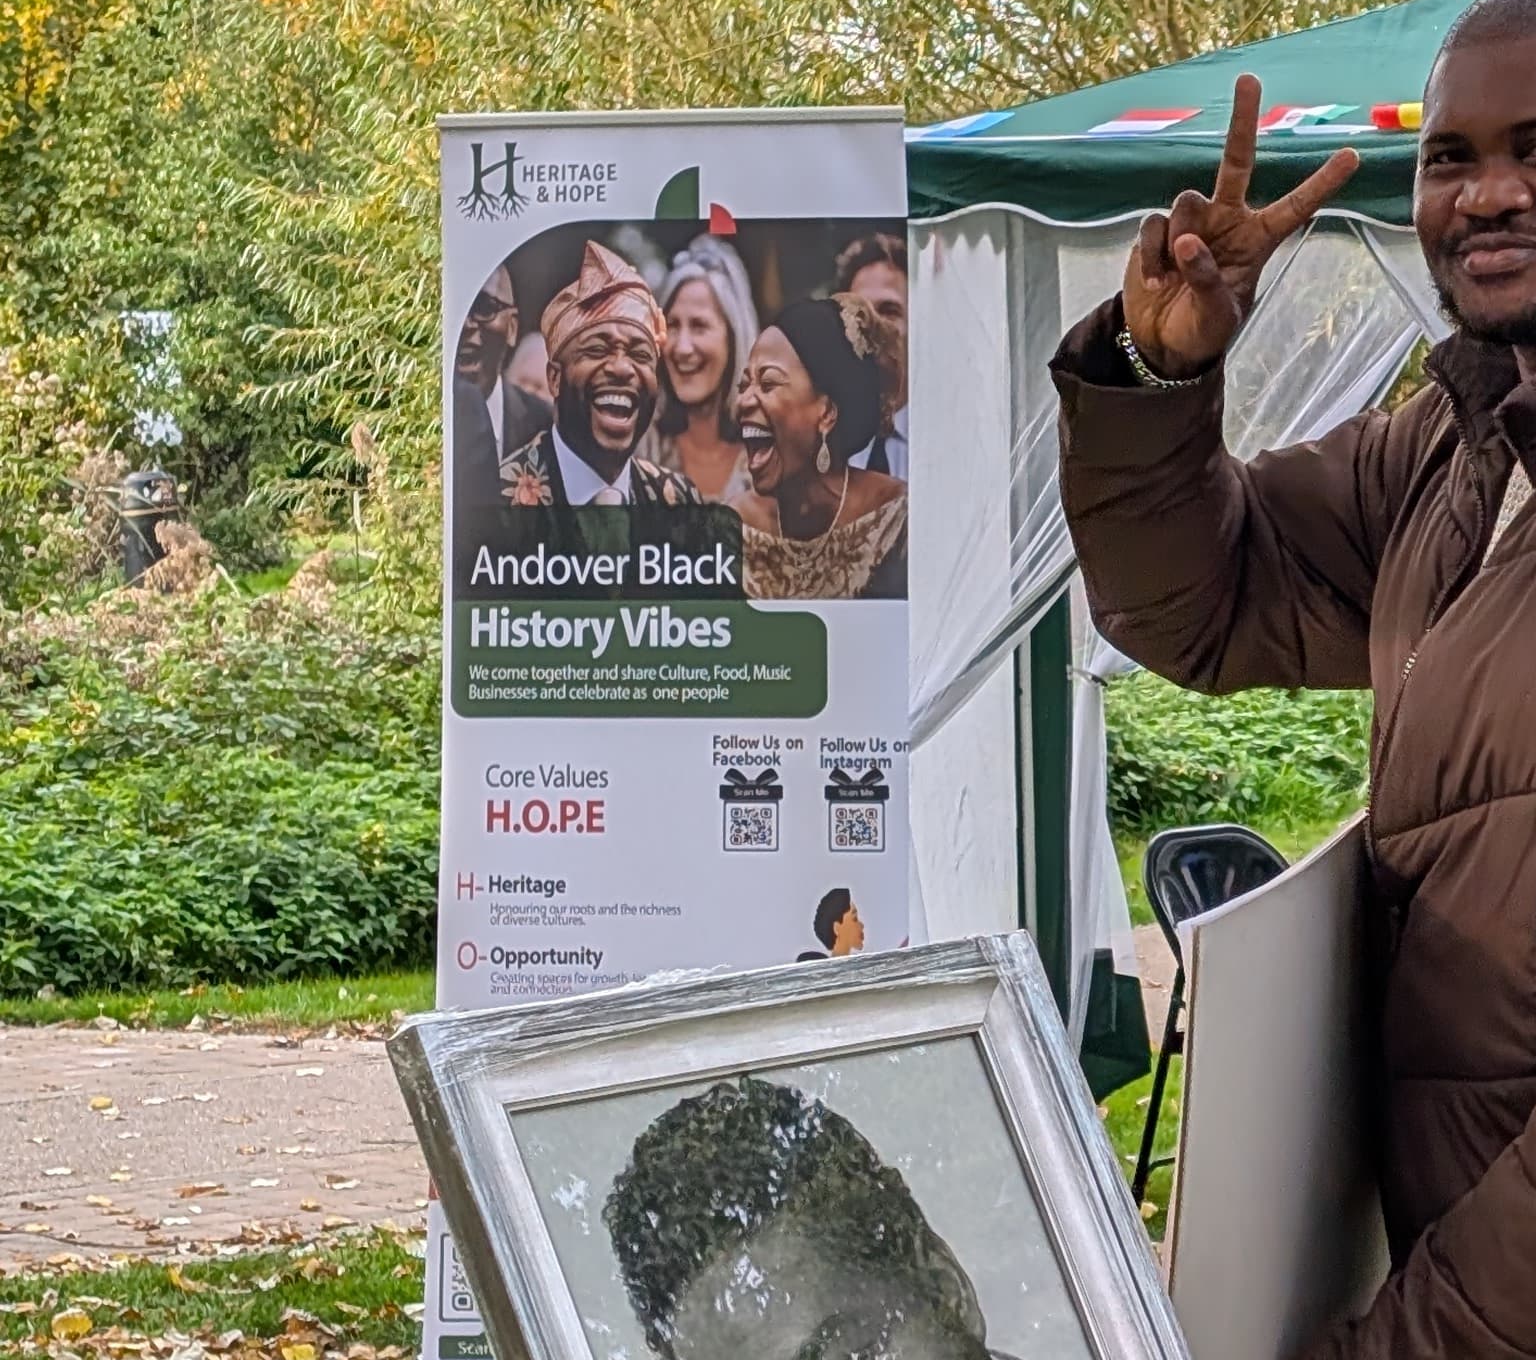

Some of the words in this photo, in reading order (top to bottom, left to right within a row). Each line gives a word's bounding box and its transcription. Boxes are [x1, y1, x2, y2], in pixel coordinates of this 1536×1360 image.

[522, 163, 618, 183] HERITAGE
[536, 185, 549, 203] &
[555, 185, 607, 202] HOPE
[470, 542, 631, 586] Andover
[638, 542, 737, 586] Black
[470, 606, 616, 659] History
[619, 605, 732, 648] Vibes
[468, 664, 489, 680] We
[491, 666, 529, 680] come
[531, 664, 590, 684] together
[592, 664, 619, 680] and
[620, 664, 657, 680] share
[658, 664, 711, 682] Culture,
[713, 664, 751, 682] Food,
[752, 664, 792, 680] Music
[468, 683, 537, 700] Businesses
[539, 683, 566, 700] and
[568, 683, 630, 700] celebrate
[632, 686, 648, 700] as
[652, 686, 680, 700] one
[681, 683, 730, 703] people
[713, 735, 759, 750] Follow
[763, 735, 780, 750] Us
[786, 737, 804, 750] on
[820, 737, 866, 753] Follow
[869, 737, 888, 753] Us
[713, 752, 781, 766] Facebook
[820, 755, 892, 773] Instagram
[485, 764, 535, 788] Core
[538, 763, 609, 788] Values
[486, 799, 605, 833] H.O.P.E
[488, 875, 566, 898] Heritage
[490, 902, 546, 918] Honouring
[549, 905, 567, 915] our
[569, 903, 596, 915] roots
[598, 903, 618, 915] and
[639, 902, 681, 915] richness
[490, 914, 501, 925] of
[502, 914, 540, 925] diverse
[542, 914, 586, 926] cultures.
[490, 946, 603, 970] Opportunity
